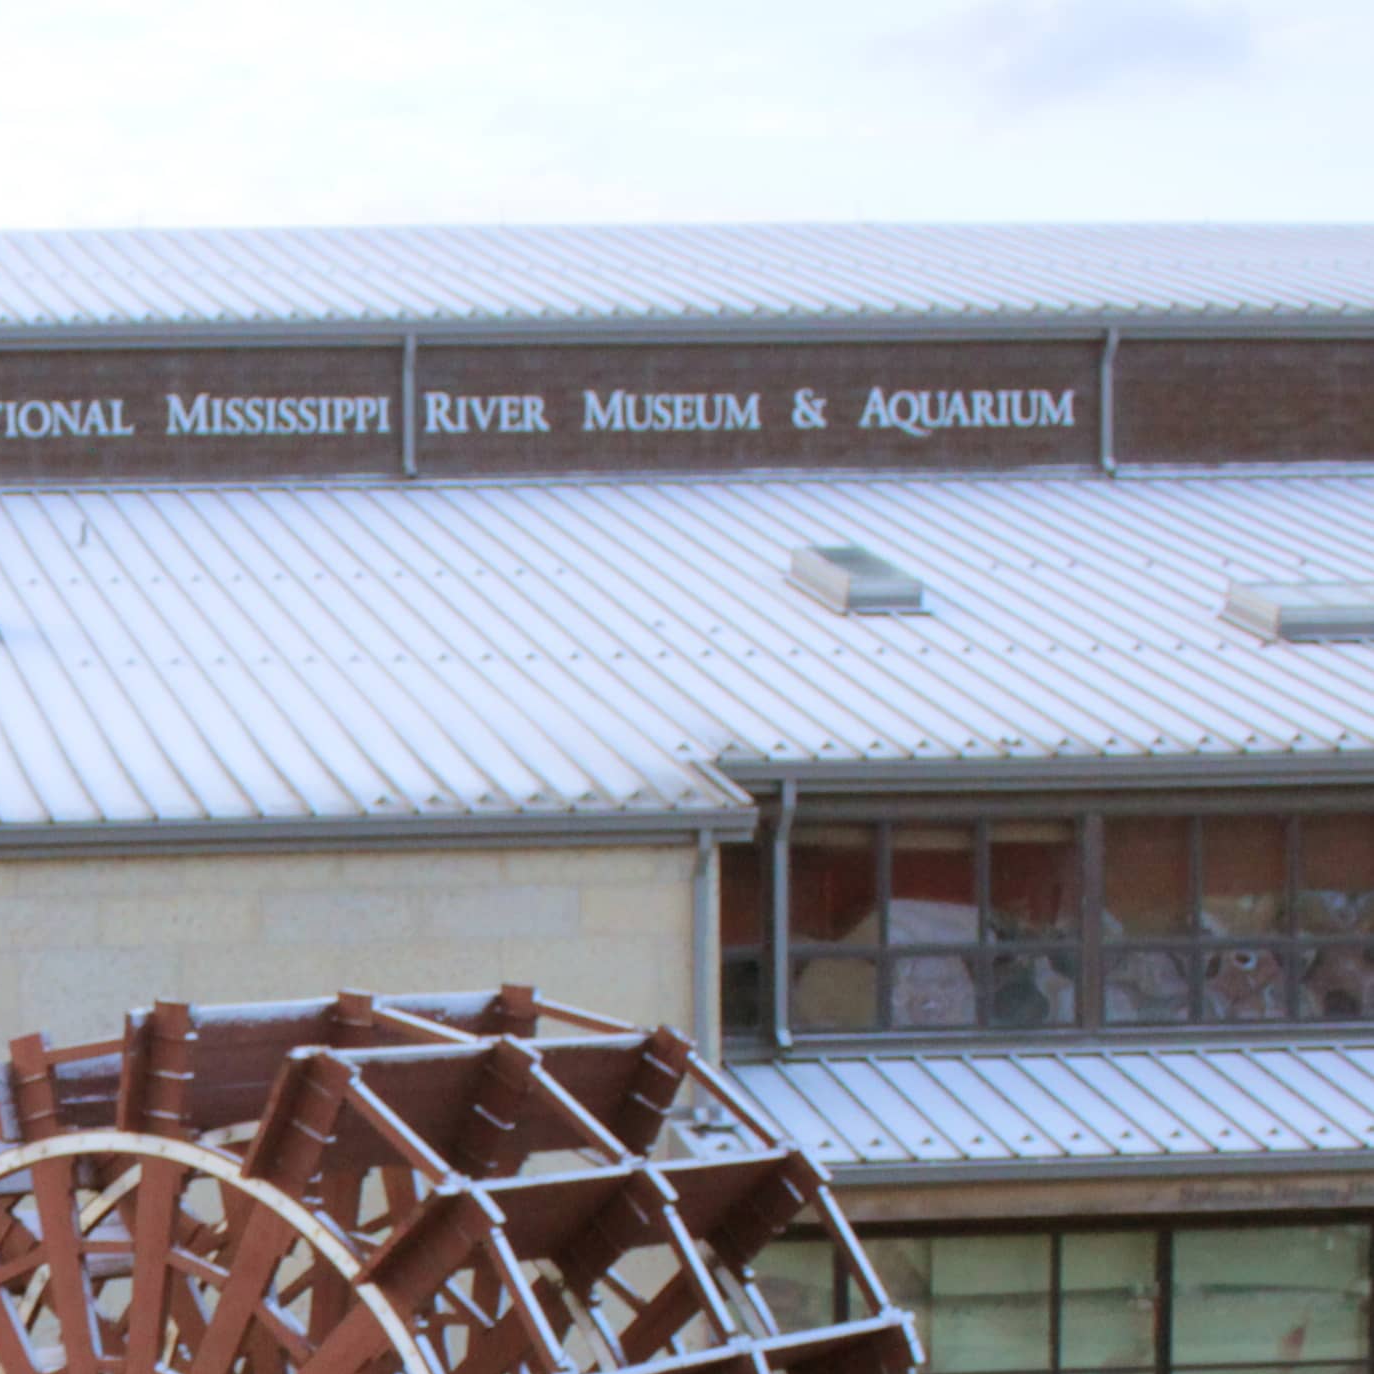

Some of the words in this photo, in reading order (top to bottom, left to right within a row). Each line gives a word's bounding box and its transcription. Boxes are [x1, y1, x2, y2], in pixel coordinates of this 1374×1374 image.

[166, 393, 390, 436] MISSISSIPPI
[425, 391, 550, 433] RIVER
[583, 389, 761, 432] MUSEUM
[791, 388, 827, 430] &
[859, 387, 1075, 437] AQUARIUM
